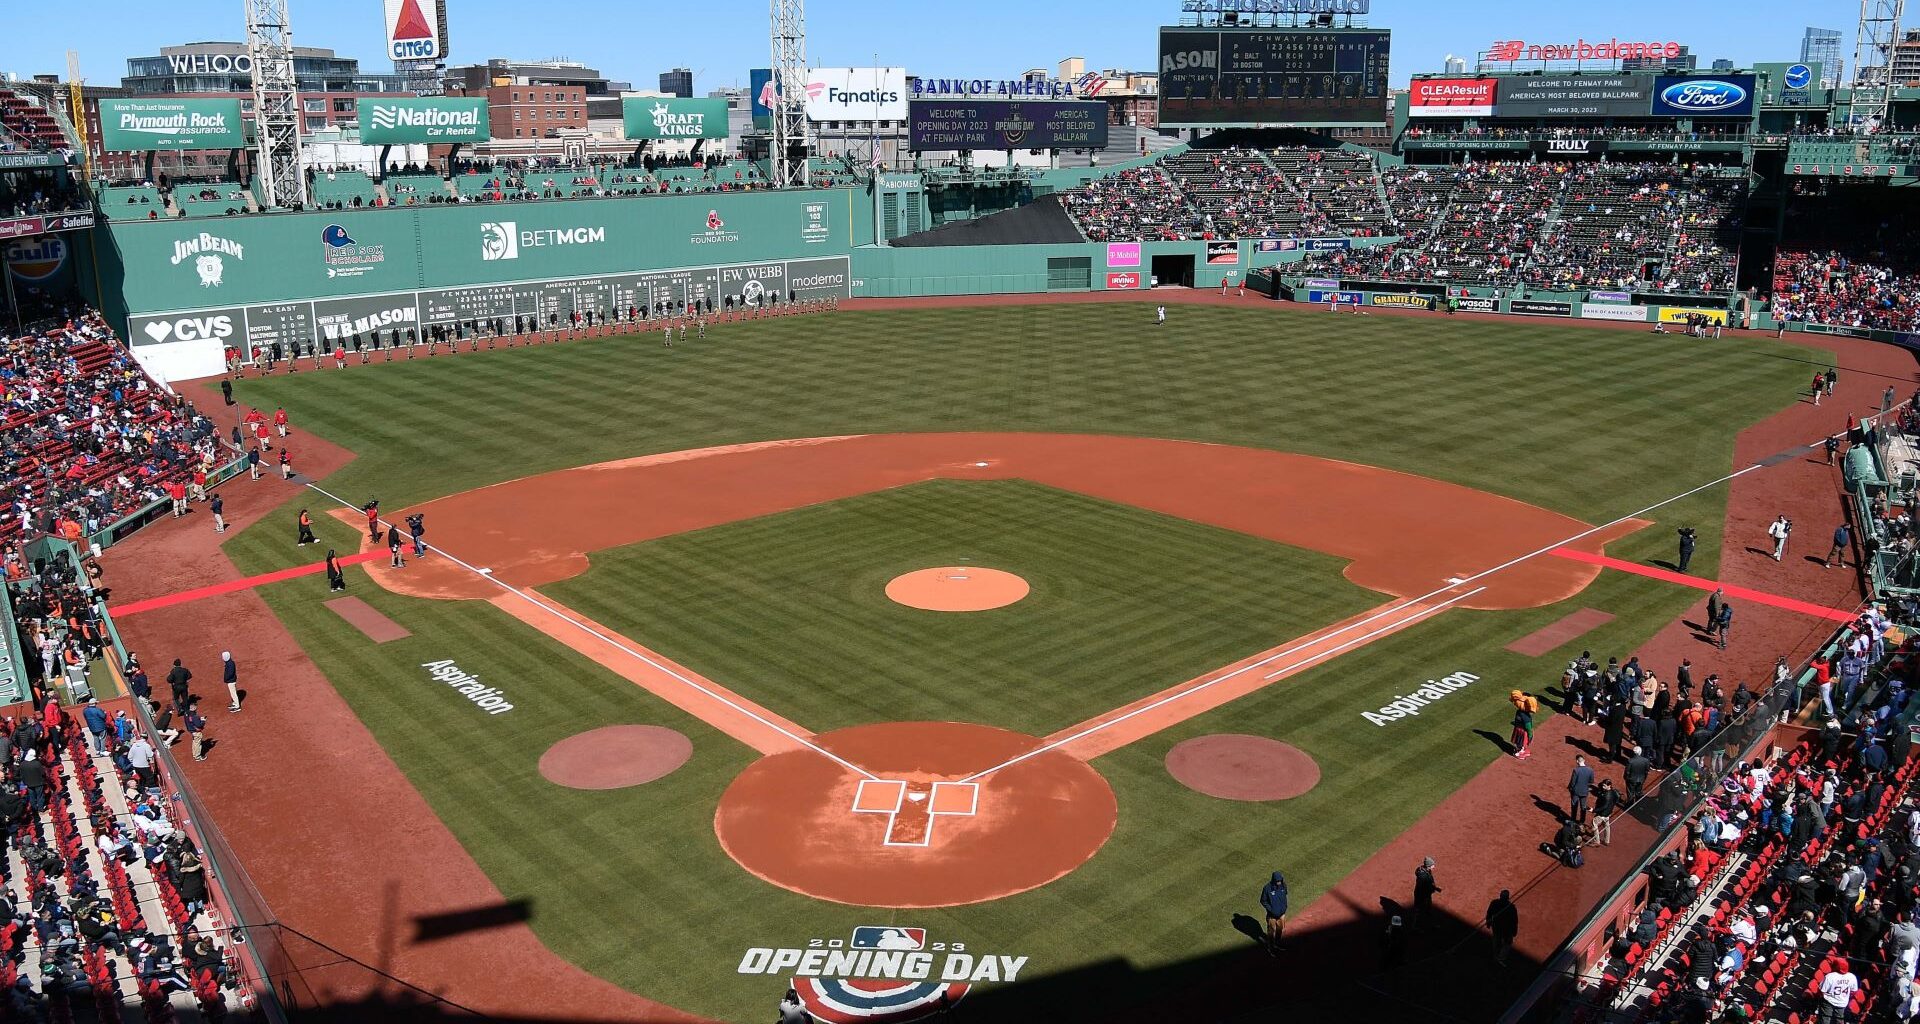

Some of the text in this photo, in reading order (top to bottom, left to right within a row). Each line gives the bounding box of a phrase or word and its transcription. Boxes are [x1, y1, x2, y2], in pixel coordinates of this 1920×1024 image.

[393, 40, 434, 57] CITGO
[913, 79, 1074, 95] BANK OF AMERICA
[1420, 84, 1488, 95] CLEAResult
[1528, 80, 1560, 88] WELCOME
[829, 87, 898, 107] Fanatics
[1602, 91, 1640, 99] BALLPARK
[1677, 84, 1728, 105] Ford
[398, 107, 479, 126] National
[929, 109, 977, 118] WELCOME TO
[1054, 110, 1089, 119] AMERICA'S
[121, 113, 225, 129] Plymouth Rock
[653, 112, 704, 127] DRAFT
[427, 127, 477, 136] Car Rental
[660, 123, 703, 135] KINGS
[917, 121, 988, 131] OPENING DAY 2023
[1047, 121, 1096, 131] MOST BELOVED
[921, 134, 985, 143] AT FENWAY PARK
[1053, 132, 1088, 141] BALLPARK
[1548, 140, 1589, 150] TRULY
[5, 156, 24, 166] LIVES
[24, 155, 49, 165] MATTER
[885, 180, 919, 189] ABIOMED
[806, 205, 823, 213] IBEW
[63, 216, 94, 228] Safelite
[521, 226, 605, 247] BETMGM
[690, 235, 739, 244] FOUNDATION
[8, 240, 64, 262] Gulf
[171, 232, 244, 265] JIM BEAM
[331, 245, 384, 257] RED SOX
[1208, 247, 1238, 255] Safelite
[331, 254, 385, 265] SCHOLARS
[746, 266, 783, 280] WEBB
[545, 281, 576, 289] AMERICAN
[792, 274, 844, 287] moderna
[1373, 295, 1430, 306] GRANITE CITY
[1458, 299, 1493, 308] wasabi
[317, 314, 349, 325] WHO BUT
[175, 315, 233, 341] CVS
[421, 659, 514, 715] Aspiration
[1360, 671, 1481, 727] Aspiration
[1757, 774, 1764, 782] 5
[809, 939, 966, 951] 20 23
[737, 947, 1029, 982] OPENING DAY
[1834, 986, 1849, 996] 34
